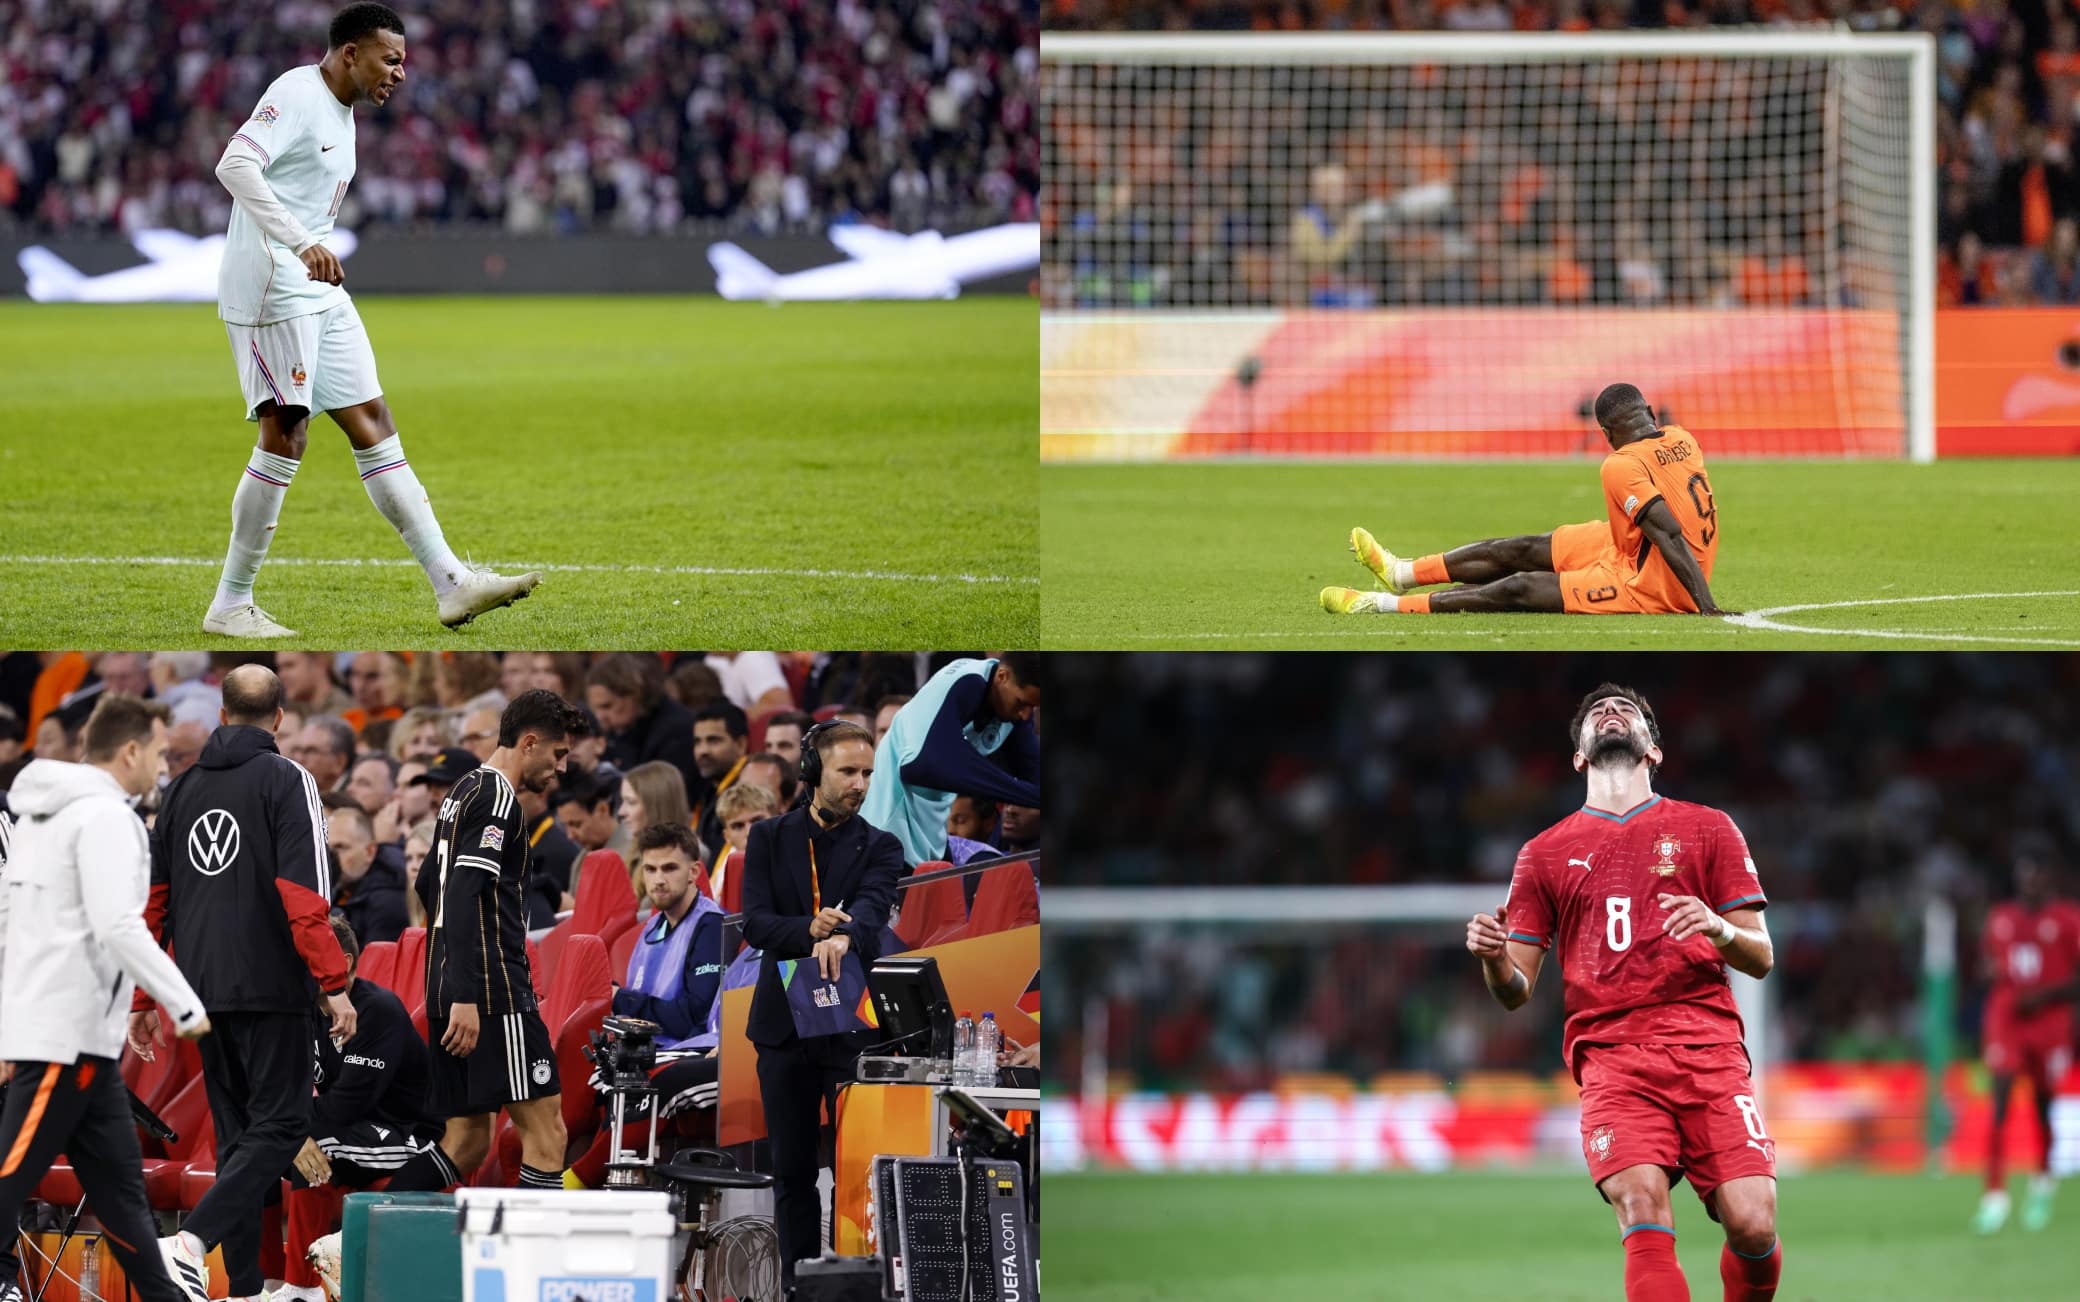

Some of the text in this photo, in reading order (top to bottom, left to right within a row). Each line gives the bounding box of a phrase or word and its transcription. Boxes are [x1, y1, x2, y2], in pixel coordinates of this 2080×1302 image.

[1687, 472, 1717, 547] 9
[433, 839, 449, 928] 7
[1606, 896, 1632, 952] 8
[1734, 1094, 1768, 1139] 8
